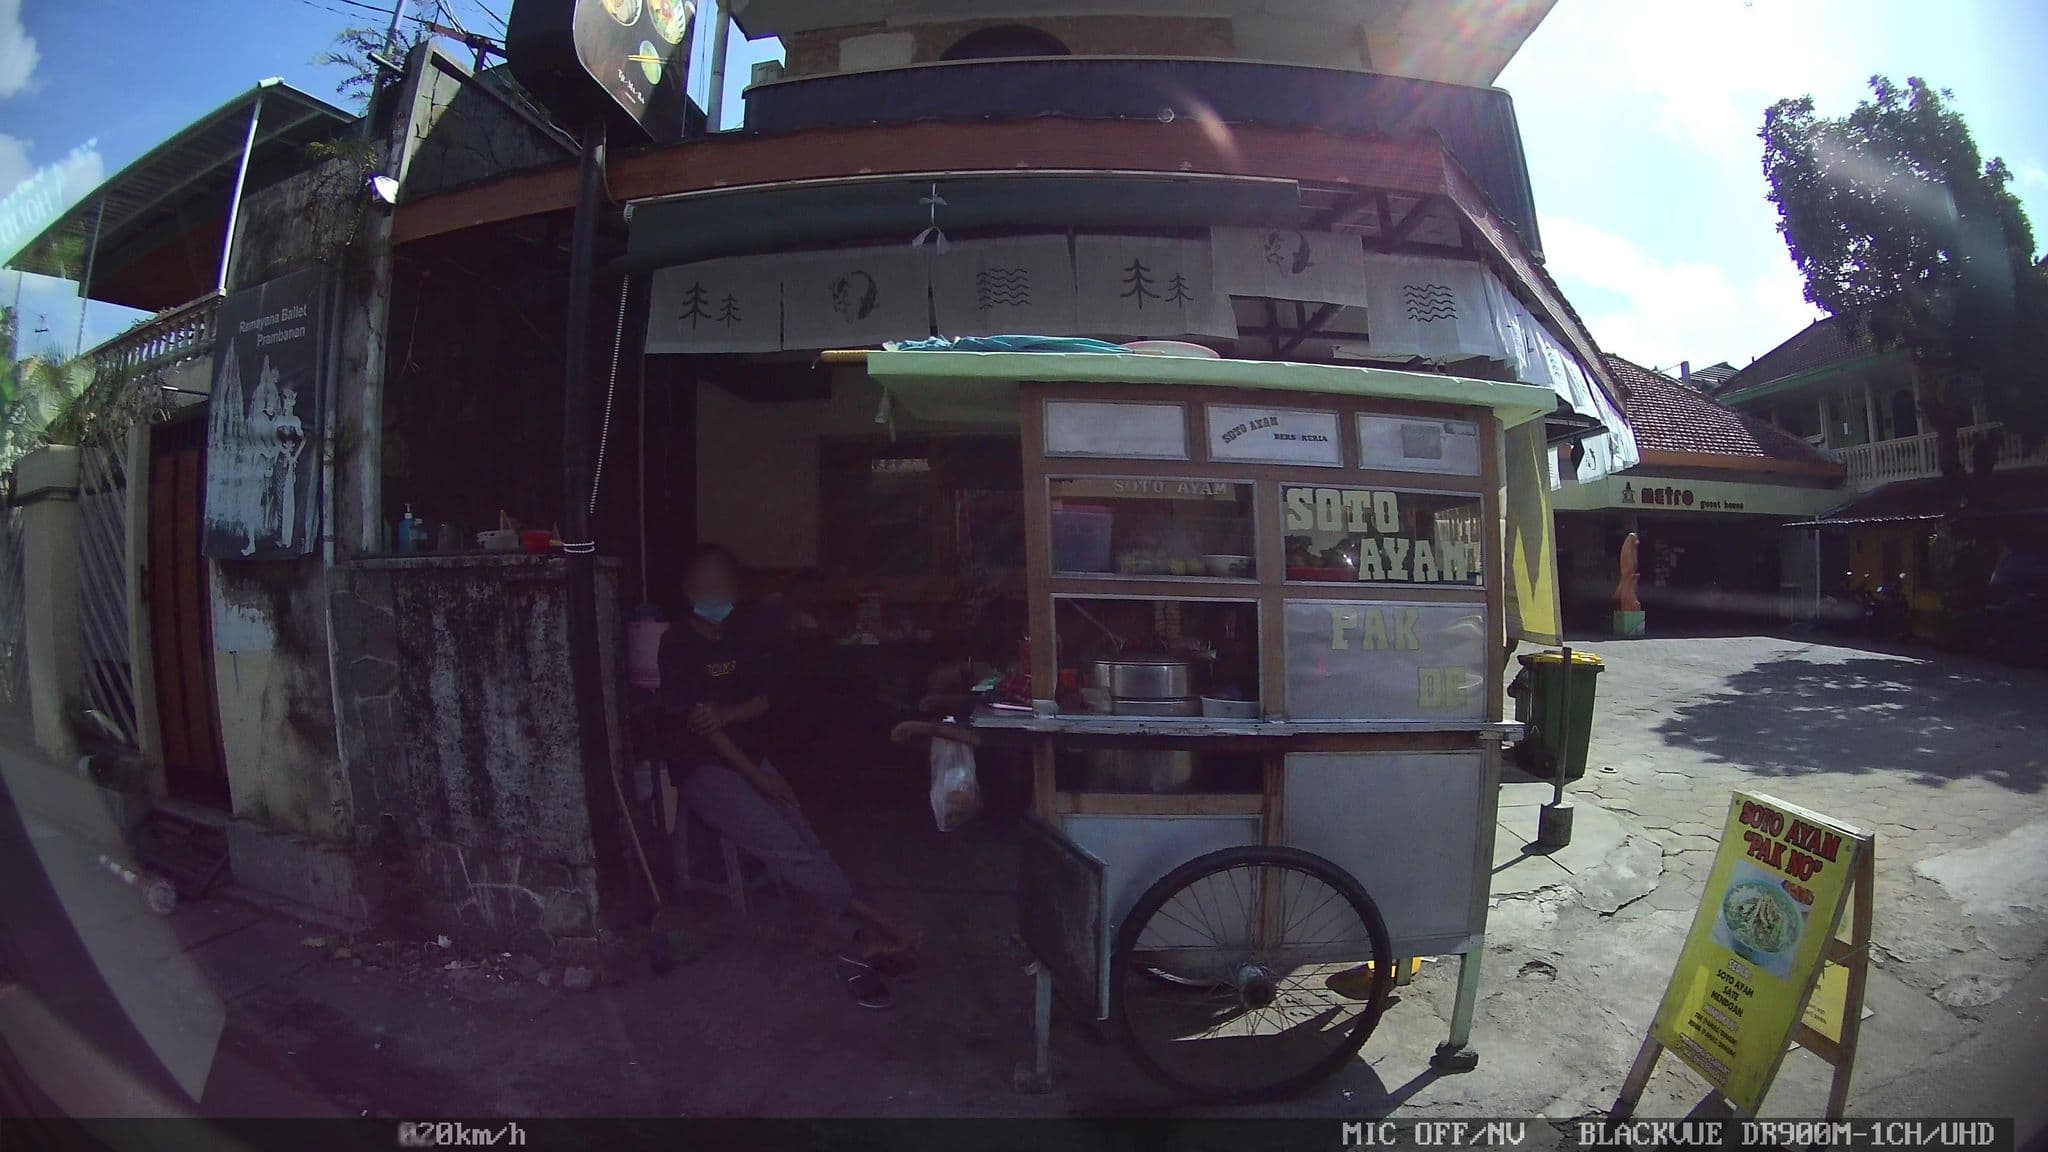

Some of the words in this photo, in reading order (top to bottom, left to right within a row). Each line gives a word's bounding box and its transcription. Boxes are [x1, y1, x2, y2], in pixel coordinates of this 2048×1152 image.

[240, 313, 280, 335] Ramayana
[281, 304, 307, 321] Ballet
[257, 326, 306, 347] Prambanan
[1221, 423, 1248, 444] SOTO
[1249, 416, 1279, 432] AYAM
[1177, 481, 1227, 496] AYAM
[1286, 487, 1400, 534] SOTO
[1331, 606, 1420, 651] PAK
[1739, 800, 1785, 838] SOTO
[1784, 819, 1842, 863] AYAM
[1716, 969, 1735, 986] SOTO
[1734, 981, 1755, 999] AYAM
[1723, 985, 1740, 1002] SATE
[1711, 990, 1744, 1018] MENDOAN
